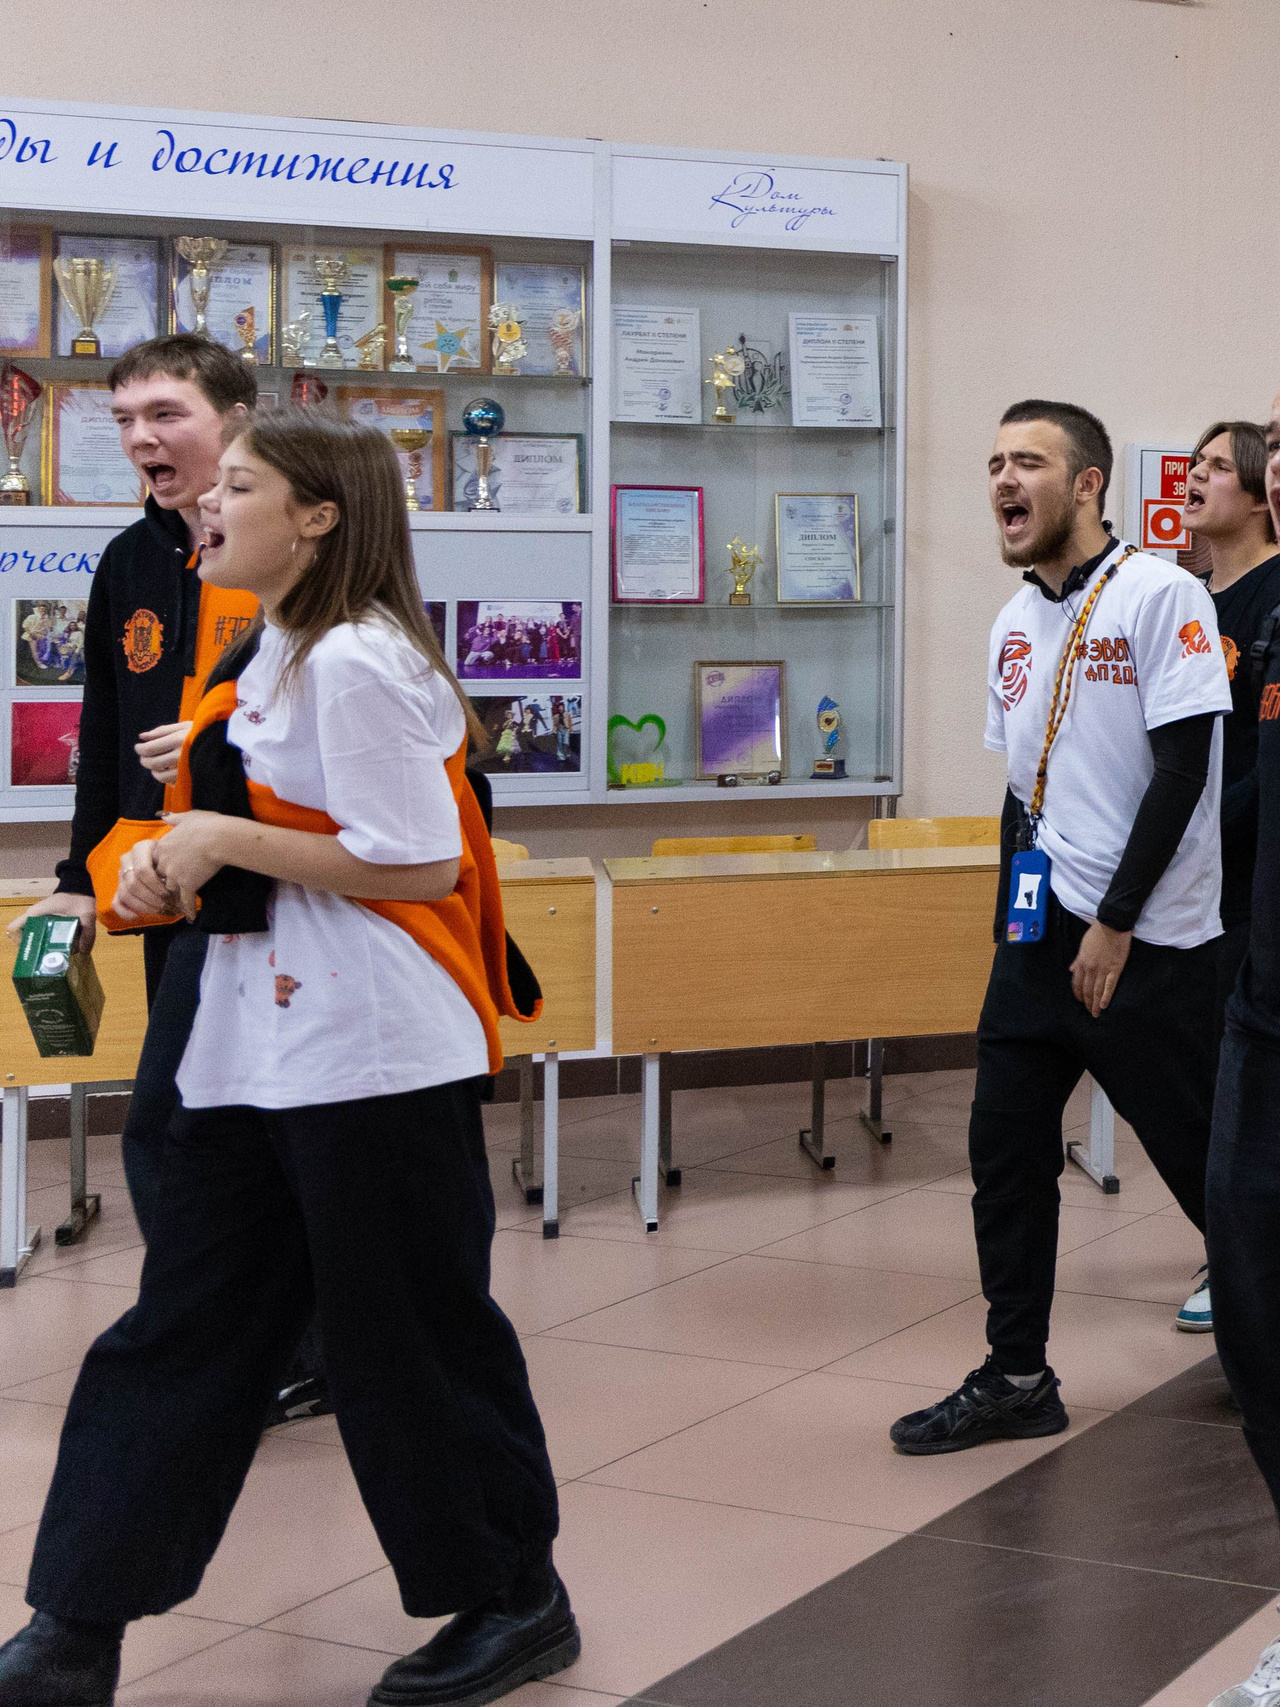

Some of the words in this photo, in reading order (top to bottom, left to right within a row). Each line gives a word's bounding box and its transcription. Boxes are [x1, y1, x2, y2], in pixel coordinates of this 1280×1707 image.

[87, 141, 122, 168] и
[152, 129, 459, 190] достижения
[733, 168, 804, 199] Дом
[709, 184, 838, 231] Культуры
[513, 454, 563, 463] ДИПЛОМ
[1164, 461, 1185, 476] ПРИ
[1173, 481, 1186, 496] ЗВ
[621, 763, 664, 784] КВН
